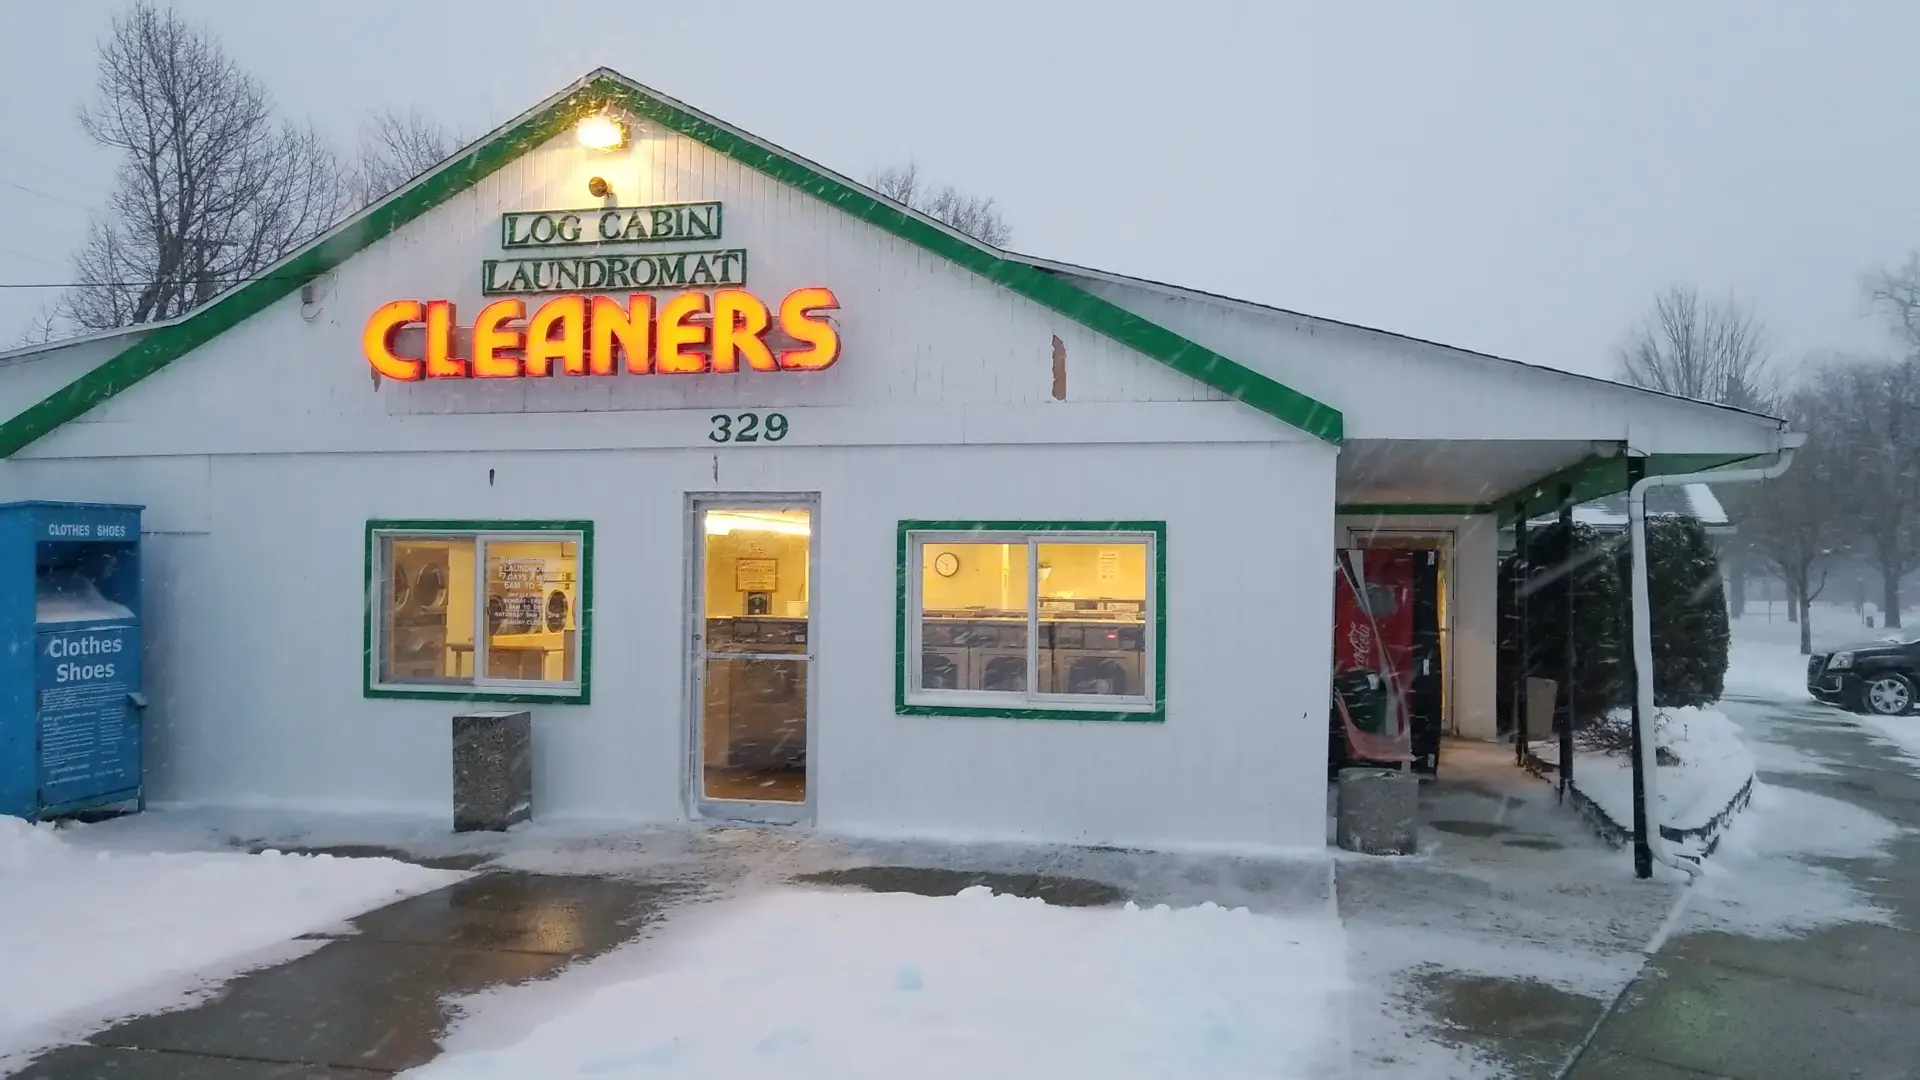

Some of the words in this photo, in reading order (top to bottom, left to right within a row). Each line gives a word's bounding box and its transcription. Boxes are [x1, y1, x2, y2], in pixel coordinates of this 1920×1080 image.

[508, 215, 582, 245] LOG
[598, 206, 714, 239] CABIN
[487, 253, 740, 291] LAUNDROMAT
[362, 286, 842, 381] CLEANERS
[708, 413, 789, 442] 329
[49, 524, 90, 536] CLOTHES
[97, 525, 126, 537] SHOES
[50, 636, 122, 658] Clothes
[56, 662, 116, 683] Shoes
